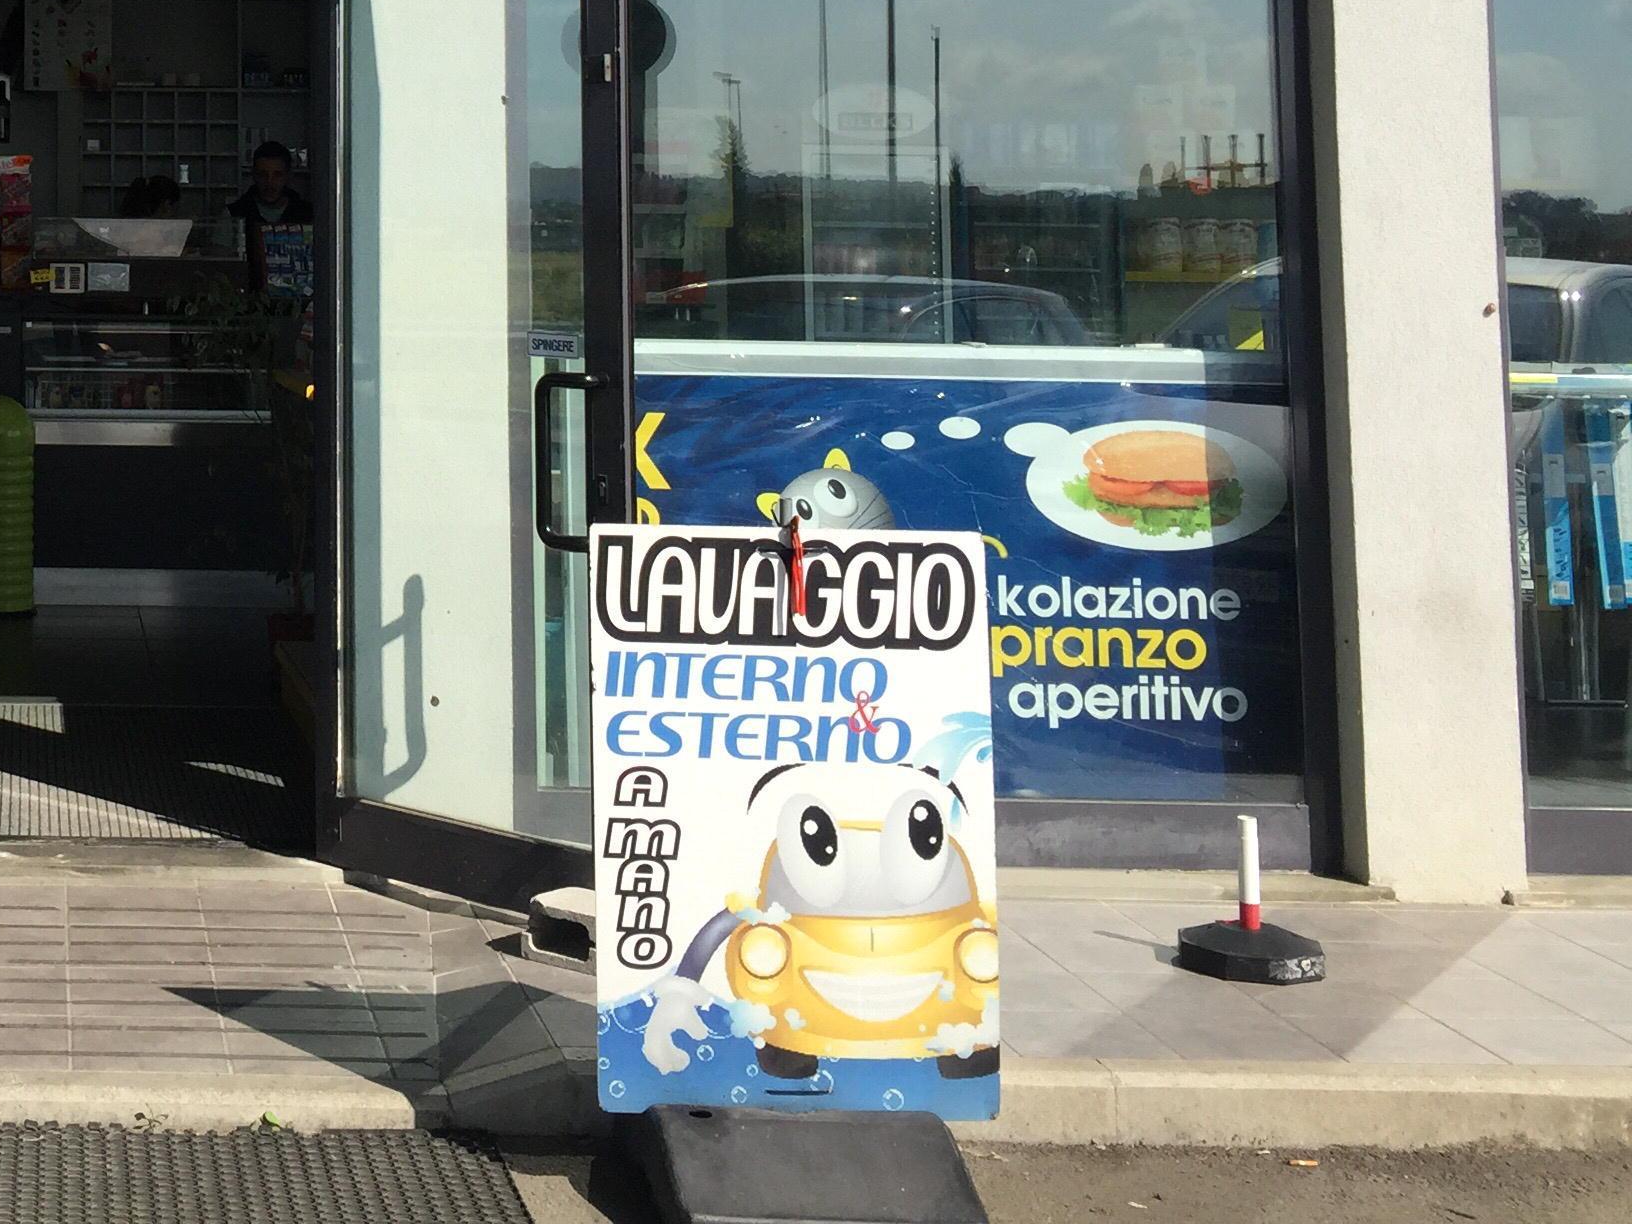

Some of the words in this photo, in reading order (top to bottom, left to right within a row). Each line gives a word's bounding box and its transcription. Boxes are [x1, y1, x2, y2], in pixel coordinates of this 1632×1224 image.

[531, 338, 575, 354] SPINGERE
[597, 533, 976, 652] LAVAGGIO
[997, 574, 1242, 620] kolazione
[989, 623, 1208, 676] pranzo
[604, 651, 888, 703] INTERNO
[1008, 674, 1249, 730] aperitivo
[605, 711, 912, 763] ESTERNO
[849, 690, 881, 734] &
